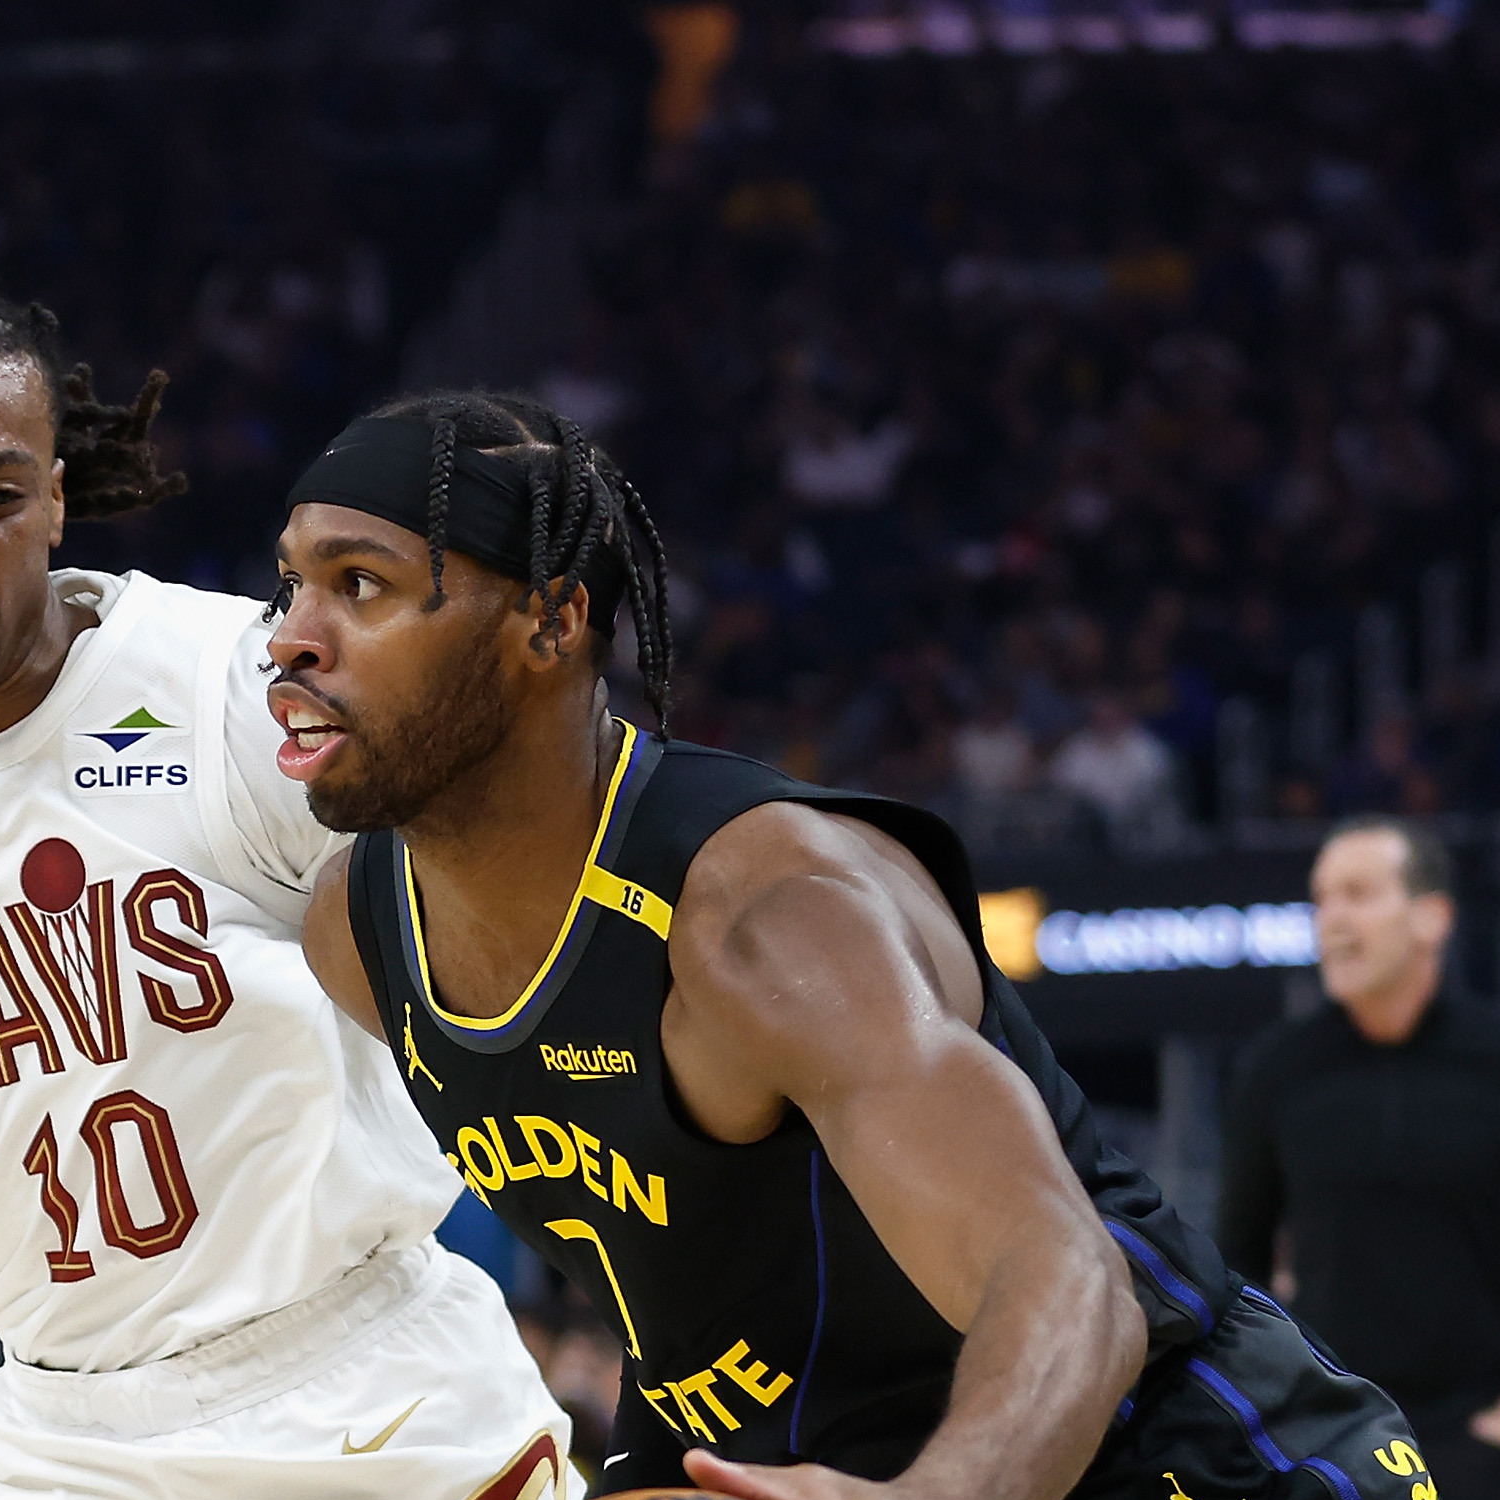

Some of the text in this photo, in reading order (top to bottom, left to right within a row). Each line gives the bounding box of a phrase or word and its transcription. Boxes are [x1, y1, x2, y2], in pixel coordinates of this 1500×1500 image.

[74, 764, 188, 789] CLIFFS
[620, 885, 644, 915] 16
[539, 1043, 637, 1074] Rakuten
[23, 1090, 198, 1283] 10
